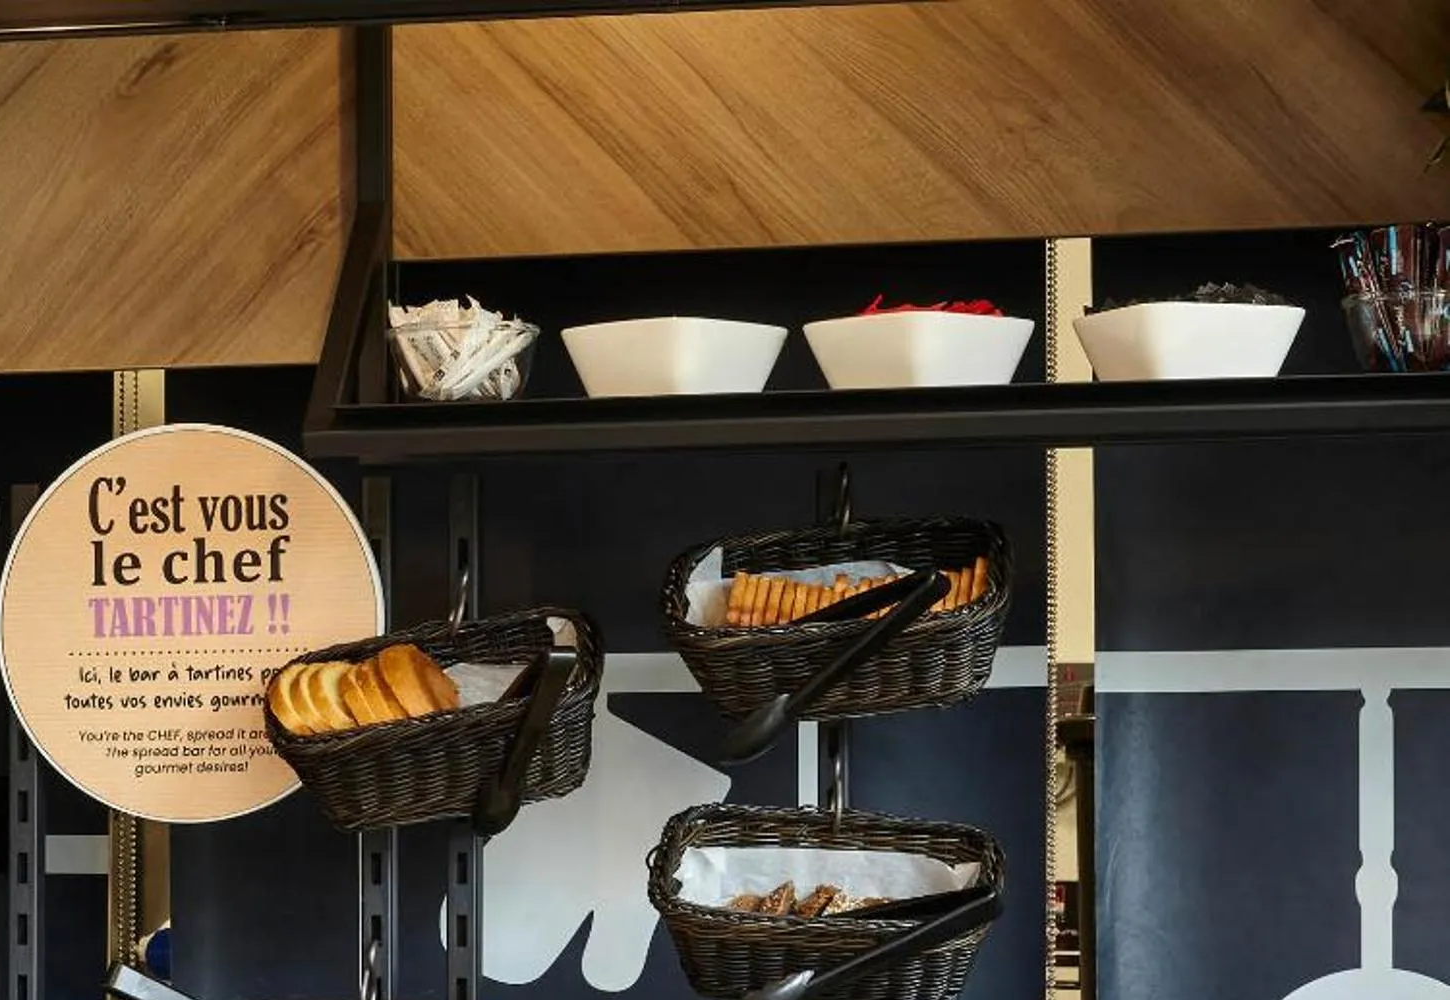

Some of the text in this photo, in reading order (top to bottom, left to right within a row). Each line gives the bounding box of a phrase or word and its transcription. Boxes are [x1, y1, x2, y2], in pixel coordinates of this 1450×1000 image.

[198, 494, 289, 532] vous
[90, 535, 290, 586] le chef
[89, 593, 290, 638] TARTINEZ !!
[79, 666, 102, 685] Ici,
[109, 667, 122, 683] le
[129, 667, 160, 682] bar
[168, 662, 179, 681] à
[186, 664, 252, 682] tartines
[64, 693, 113, 710] toutes
[120, 694, 147, 708] vos
[154, 692, 204, 709] envies
[123, 731, 144, 741] the
[148, 730, 182, 742] CHEF,
[187, 729, 234, 742] spread
[238, 729, 248, 739] it
[106, 747, 128, 758] The
[132, 747, 179, 760] spread
[183, 746, 205, 757] bar
[209, 745, 227, 757] for
[230, 745, 246, 757] all
[135, 761, 248, 778] gourmet desires!
